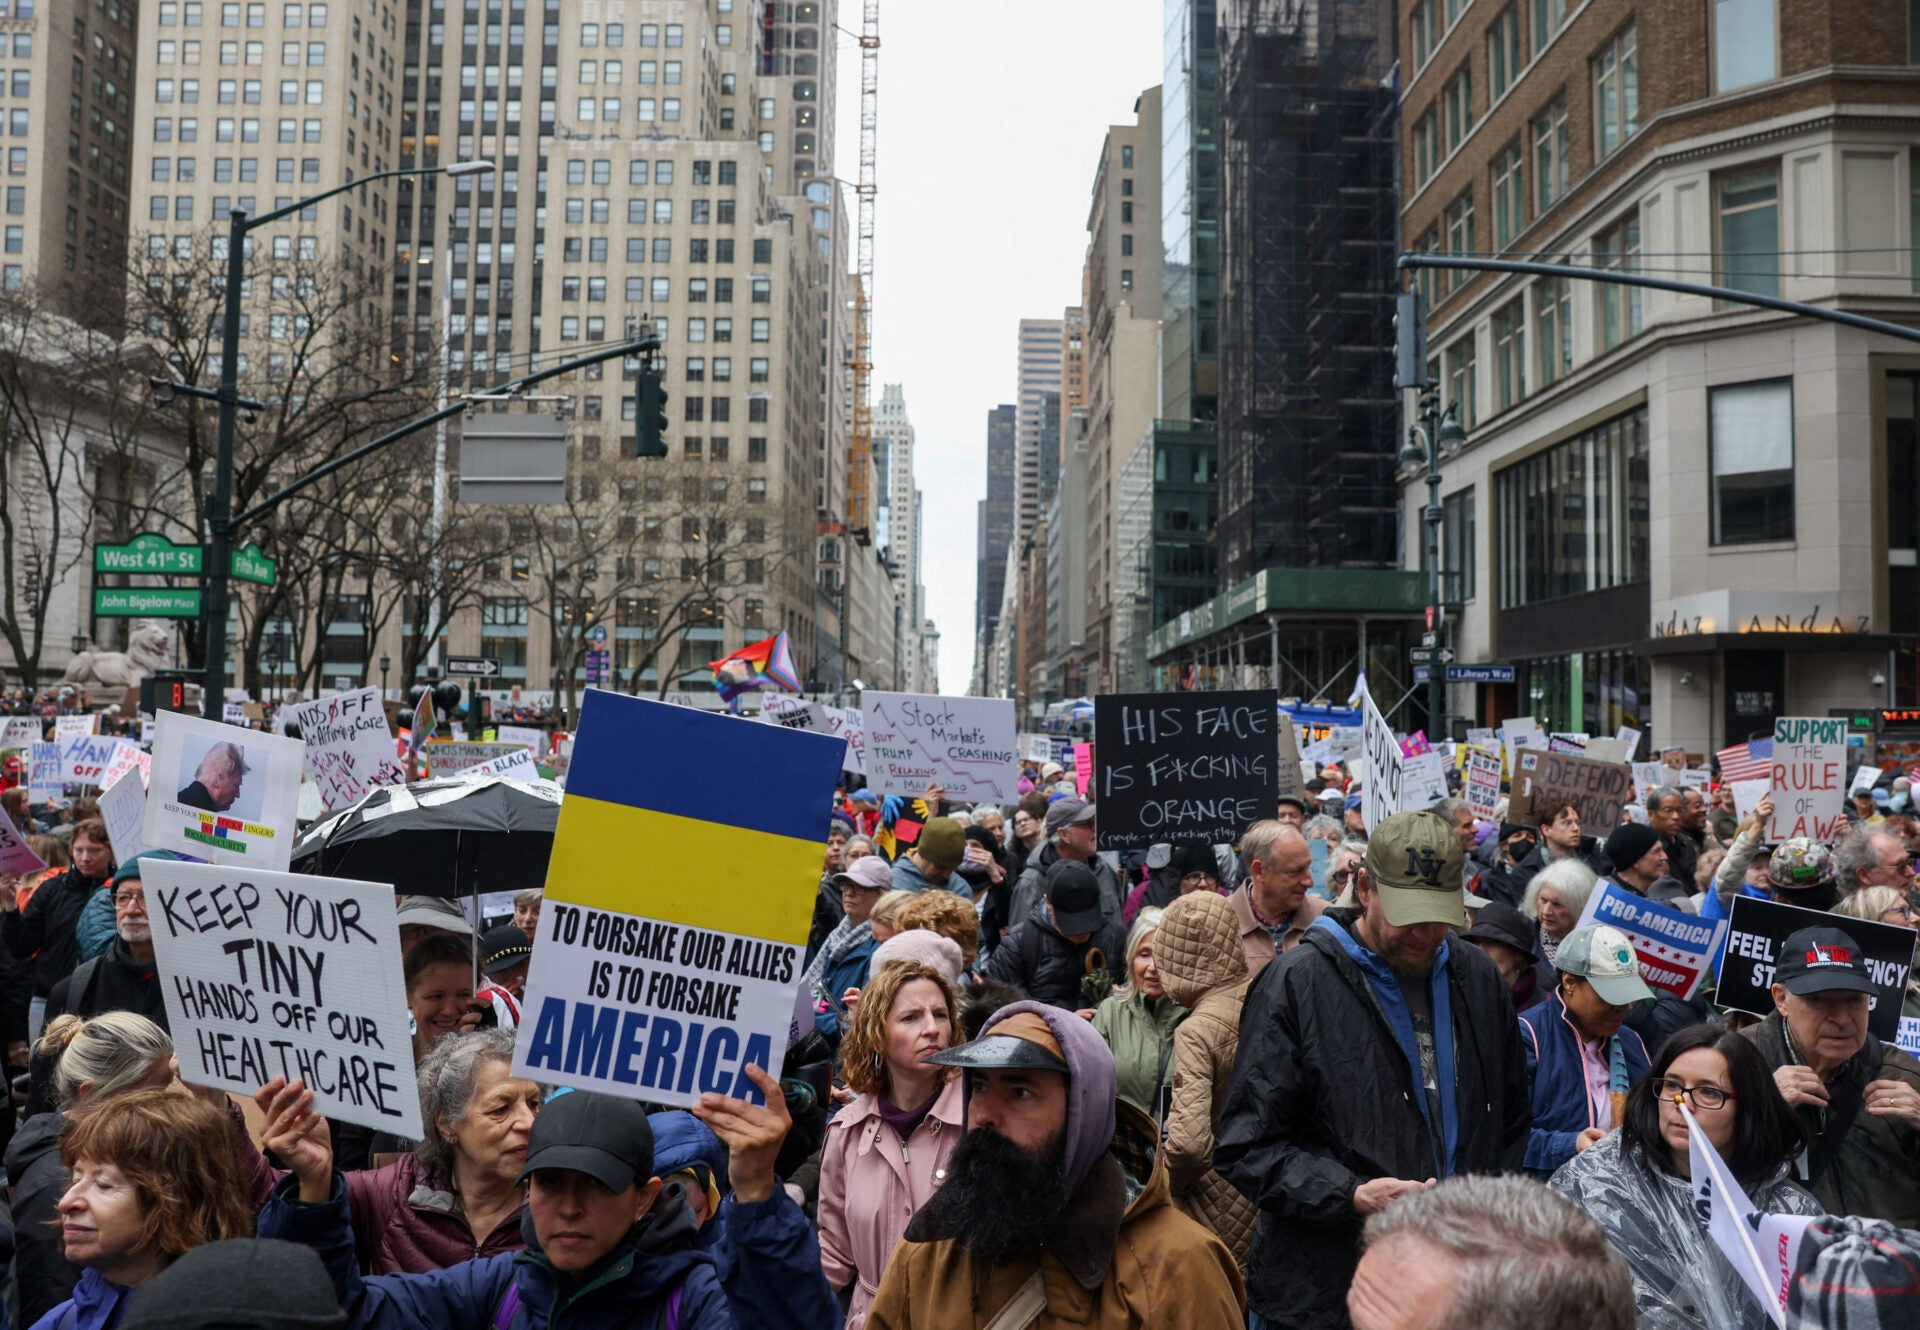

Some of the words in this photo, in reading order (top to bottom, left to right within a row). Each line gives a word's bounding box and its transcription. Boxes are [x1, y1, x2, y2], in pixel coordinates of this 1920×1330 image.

[103, 551, 144, 567] West
[147, 551, 175, 567] 41st
[179, 551, 194, 568] St
[235, 557, 253, 575] Fifth
[253, 563, 268, 579] Ave
[101, 595, 126, 608] John
[129, 595, 172, 610] Bigelow
[174, 598, 194, 607] Plaza
[1457, 669, 1490, 680] Library
[1492, 669, 1512, 680] Way
[356, 717, 384, 730] Care
[778, 708, 808, 720] HANDS
[902, 701, 955, 727] Stock
[1122, 706, 1183, 745] HIS
[1196, 706, 1268, 739] FACE
[872, 732, 895, 743] BUT
[931, 727, 985, 744] Market's
[1775, 719, 1847, 745] SUPPORT
[431, 758, 457, 769] CHAOS
[494, 752, 532, 773] BLACK
[873, 748, 912, 760] TRUMP
[947, 747, 1012, 763] CRASHING
[1791, 745, 1823, 759] THE
[74, 765, 102, 777] OFF
[889, 764, 937, 775] RELAXING
[1105, 765, 1134, 797] IS
[1548, 758, 1625, 796] DEFEND
[1772, 763, 1838, 791] RULE
[1140, 797, 1259, 827] ORANGE
[1795, 798, 1814, 814] OF
[164, 803, 180, 815] KEEP
[181, 808, 197, 819] YOUR
[217, 818, 243, 831] STICKY
[244, 824, 275, 838] FINGERS
[185, 828, 206, 843] SOCIAL
[208, 836, 247, 852] SECURITY
[1404, 845, 1446, 886] NY
[158, 882, 260, 937] KEEP
[275, 888, 377, 945] YOUR
[1601, 894, 1712, 945] PRO-AMERICA
[552, 905, 581, 945] TO
[582, 911, 678, 963] FORSAKE
[679, 928, 727, 972] OUR
[726, 938, 796, 984] ALLIES
[1728, 931, 1774, 962] FEEL
[222, 938, 325, 1007] TINY
[1639, 961, 1686, 987] RUMP
[588, 960, 612, 999] IS
[616, 965, 645, 1005] TO
[646, 971, 742, 1022] FORSAKE
[174, 975, 259, 1024] HANDS
[272, 1001, 317, 1033] OFF
[327, 1011, 384, 1050] OUR
[526, 996, 772, 1106] AMERICA
[197, 1028, 402, 1118] HEALTHCARE
